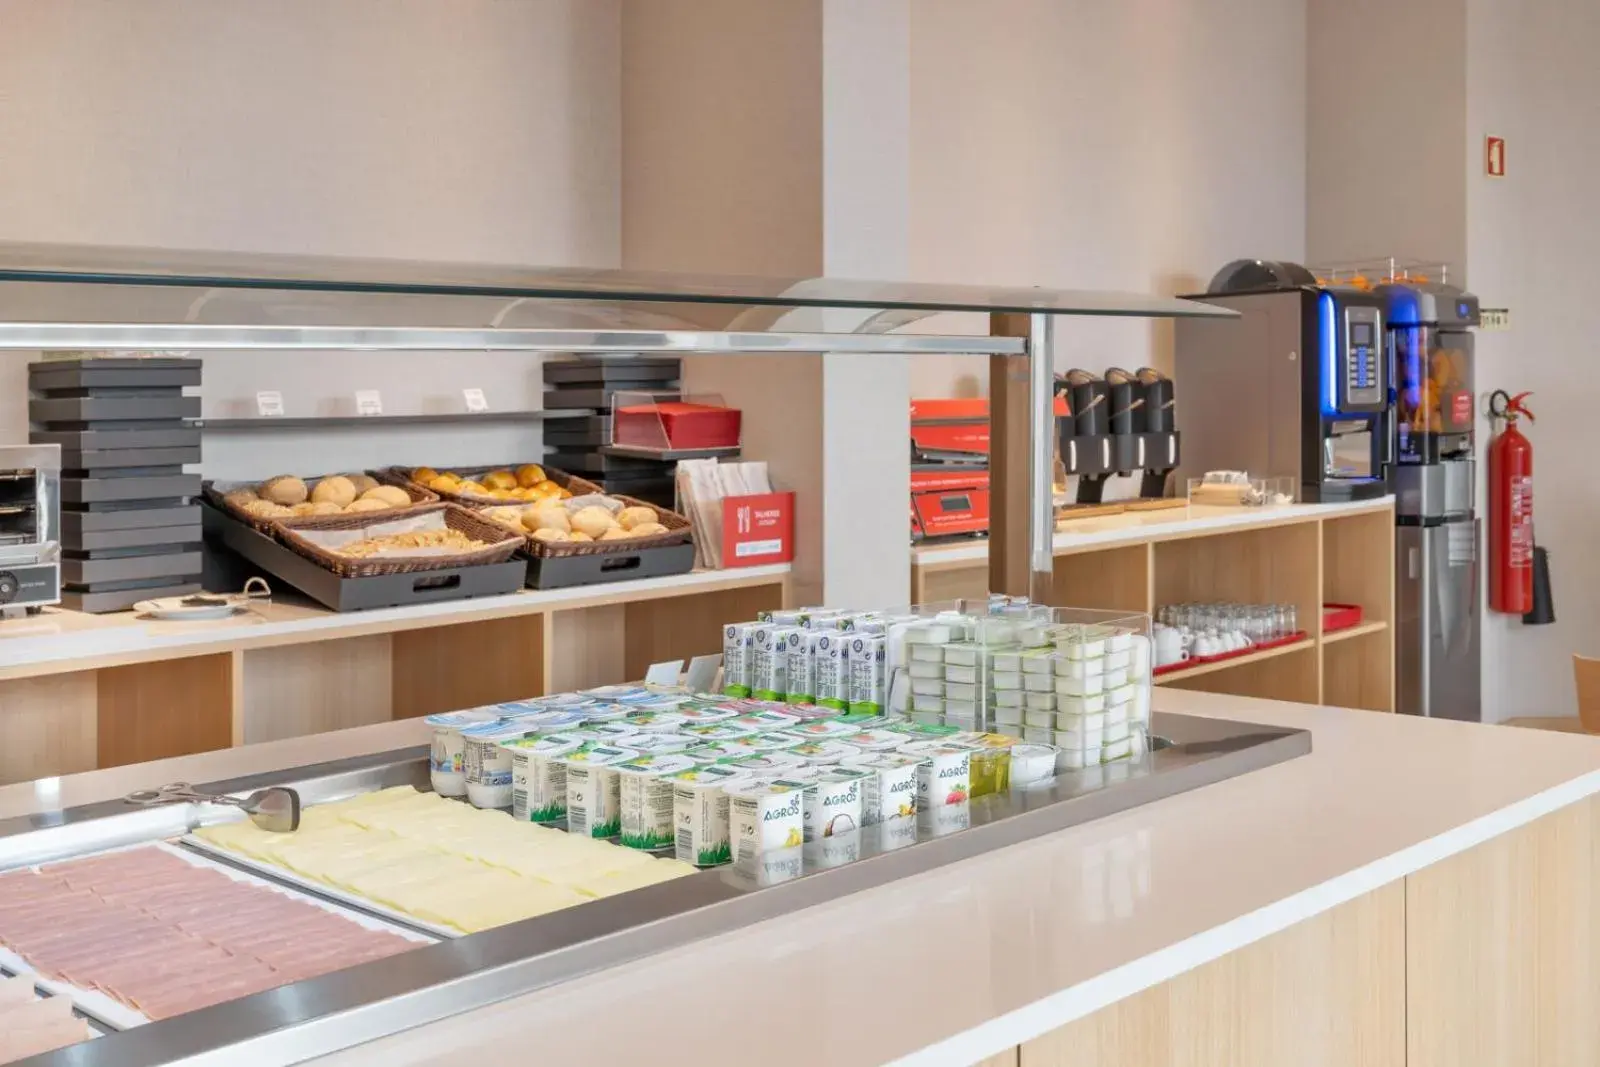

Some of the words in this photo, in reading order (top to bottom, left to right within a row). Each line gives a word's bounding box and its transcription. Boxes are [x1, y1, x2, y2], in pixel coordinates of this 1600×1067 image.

[939, 766, 968, 779] AGROS
[823, 793, 857, 807] AGROS
[764, 805, 800, 822] AGROS
